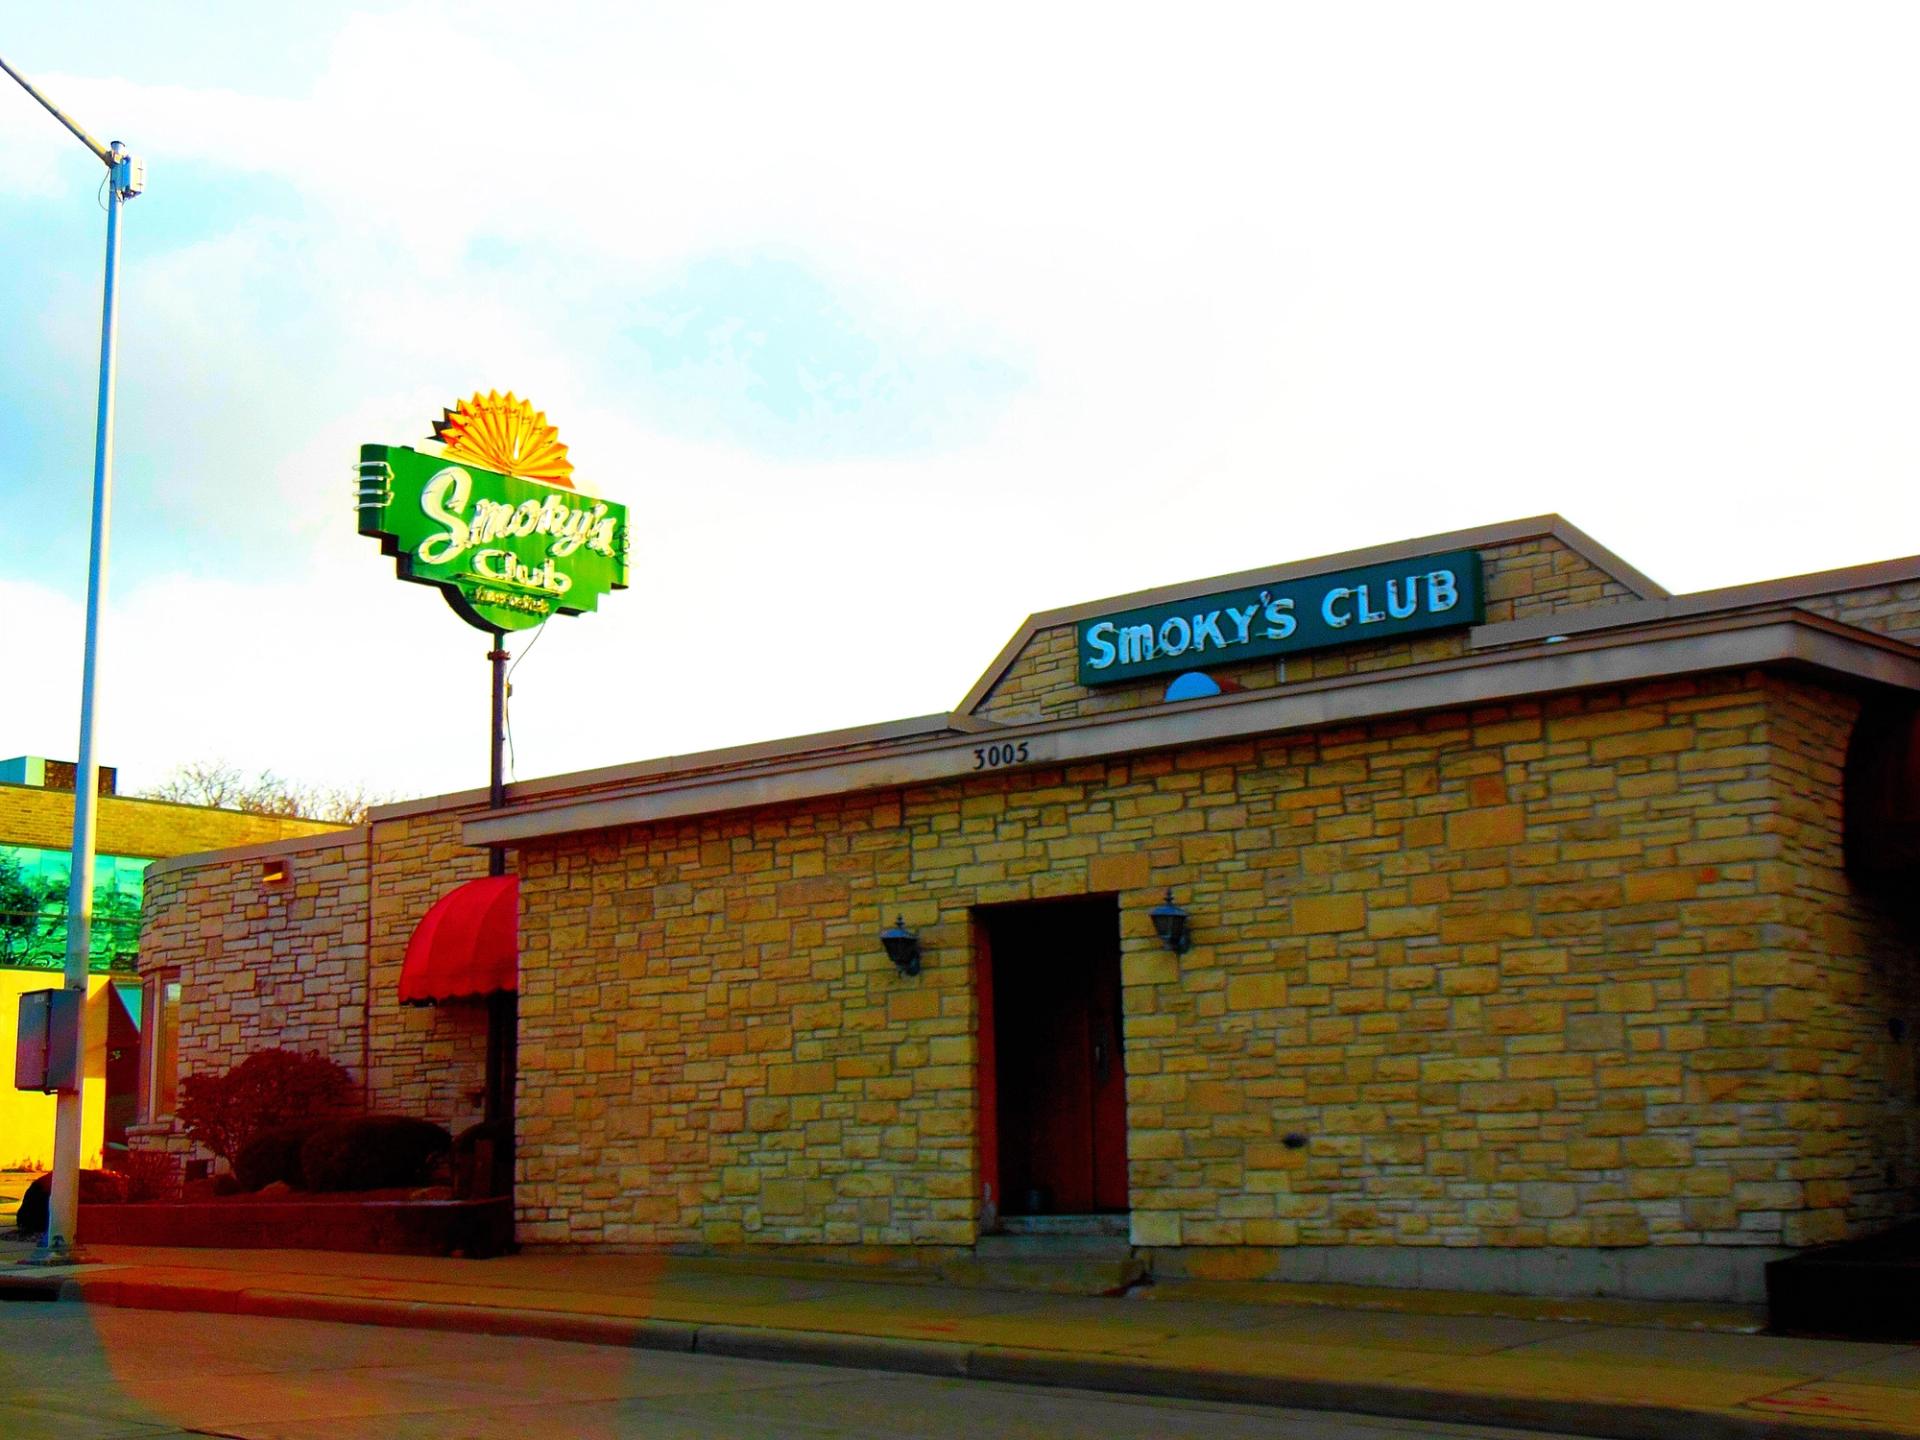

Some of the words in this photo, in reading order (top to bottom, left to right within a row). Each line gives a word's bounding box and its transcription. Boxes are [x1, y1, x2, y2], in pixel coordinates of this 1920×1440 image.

[418, 466, 616, 564] Smoky's
[473, 548, 572, 592] Club
[1321, 569, 1459, 628] CLUB
[973, 741, 1029, 770] 3005
